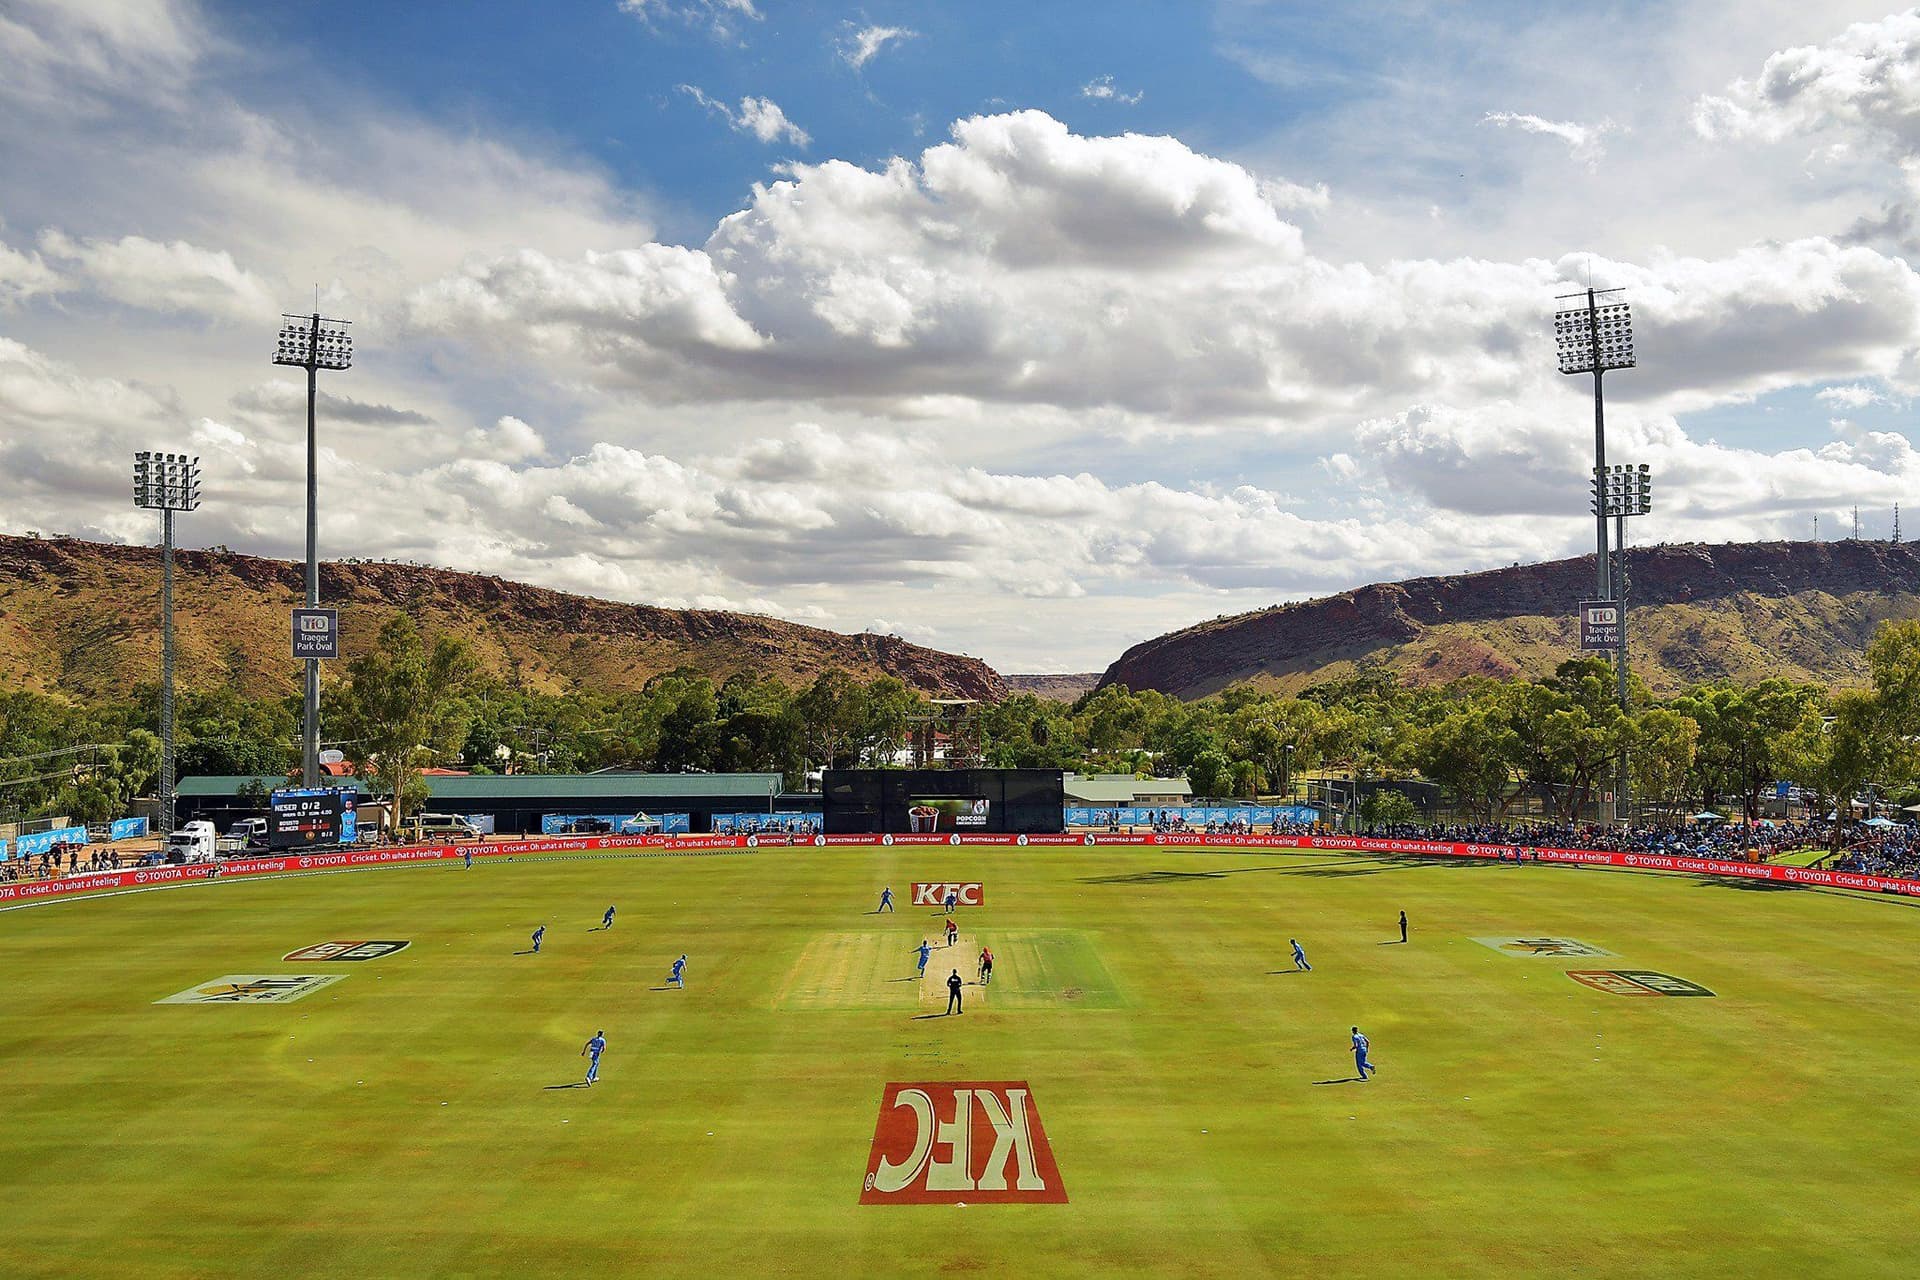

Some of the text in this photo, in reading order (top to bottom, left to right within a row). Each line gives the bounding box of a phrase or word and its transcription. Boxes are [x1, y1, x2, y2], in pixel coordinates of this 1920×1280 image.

[1588, 626, 1617, 634] Traeger
[301, 634, 328, 642] Traeger
[297, 642, 332, 650] Park Oval
[468, 846, 498, 854] TOYOTA
[563, 840, 588, 850] feeling!
[710, 838, 736, 847] feeling!
[1271, 838, 1298, 847] feeling!
[1326, 839, 1357, 848] TOYOTA
[1426, 844, 1454, 853] feeling!
[313, 856, 346, 866] TOYOTA
[392, 851, 410, 859] what
[416, 849, 443, 858] feeling!
[1560, 851, 1578, 860] what
[1584, 852, 1612, 864] feeling!
[149, 870, 182, 881] TOYOTA
[230, 863, 250, 872] what
[257, 860, 286, 871] feeling!
[1640, 856, 1672, 867] TOYOTA
[1708, 862, 1719, 870] Oh
[1720, 863, 1738, 872] what
[1744, 866, 1772, 878] feeling!
[52, 882, 64, 891] Oh
[65, 879, 84, 890] what
[92, 876, 121, 888] feeling!
[1799, 872, 1832, 882] TOYOTA
[1866, 878, 1878, 888] Oh
[1880, 881, 1900, 890] what
[913, 884, 980, 904] KFC
[874, 1088, 1046, 1192] KFC
